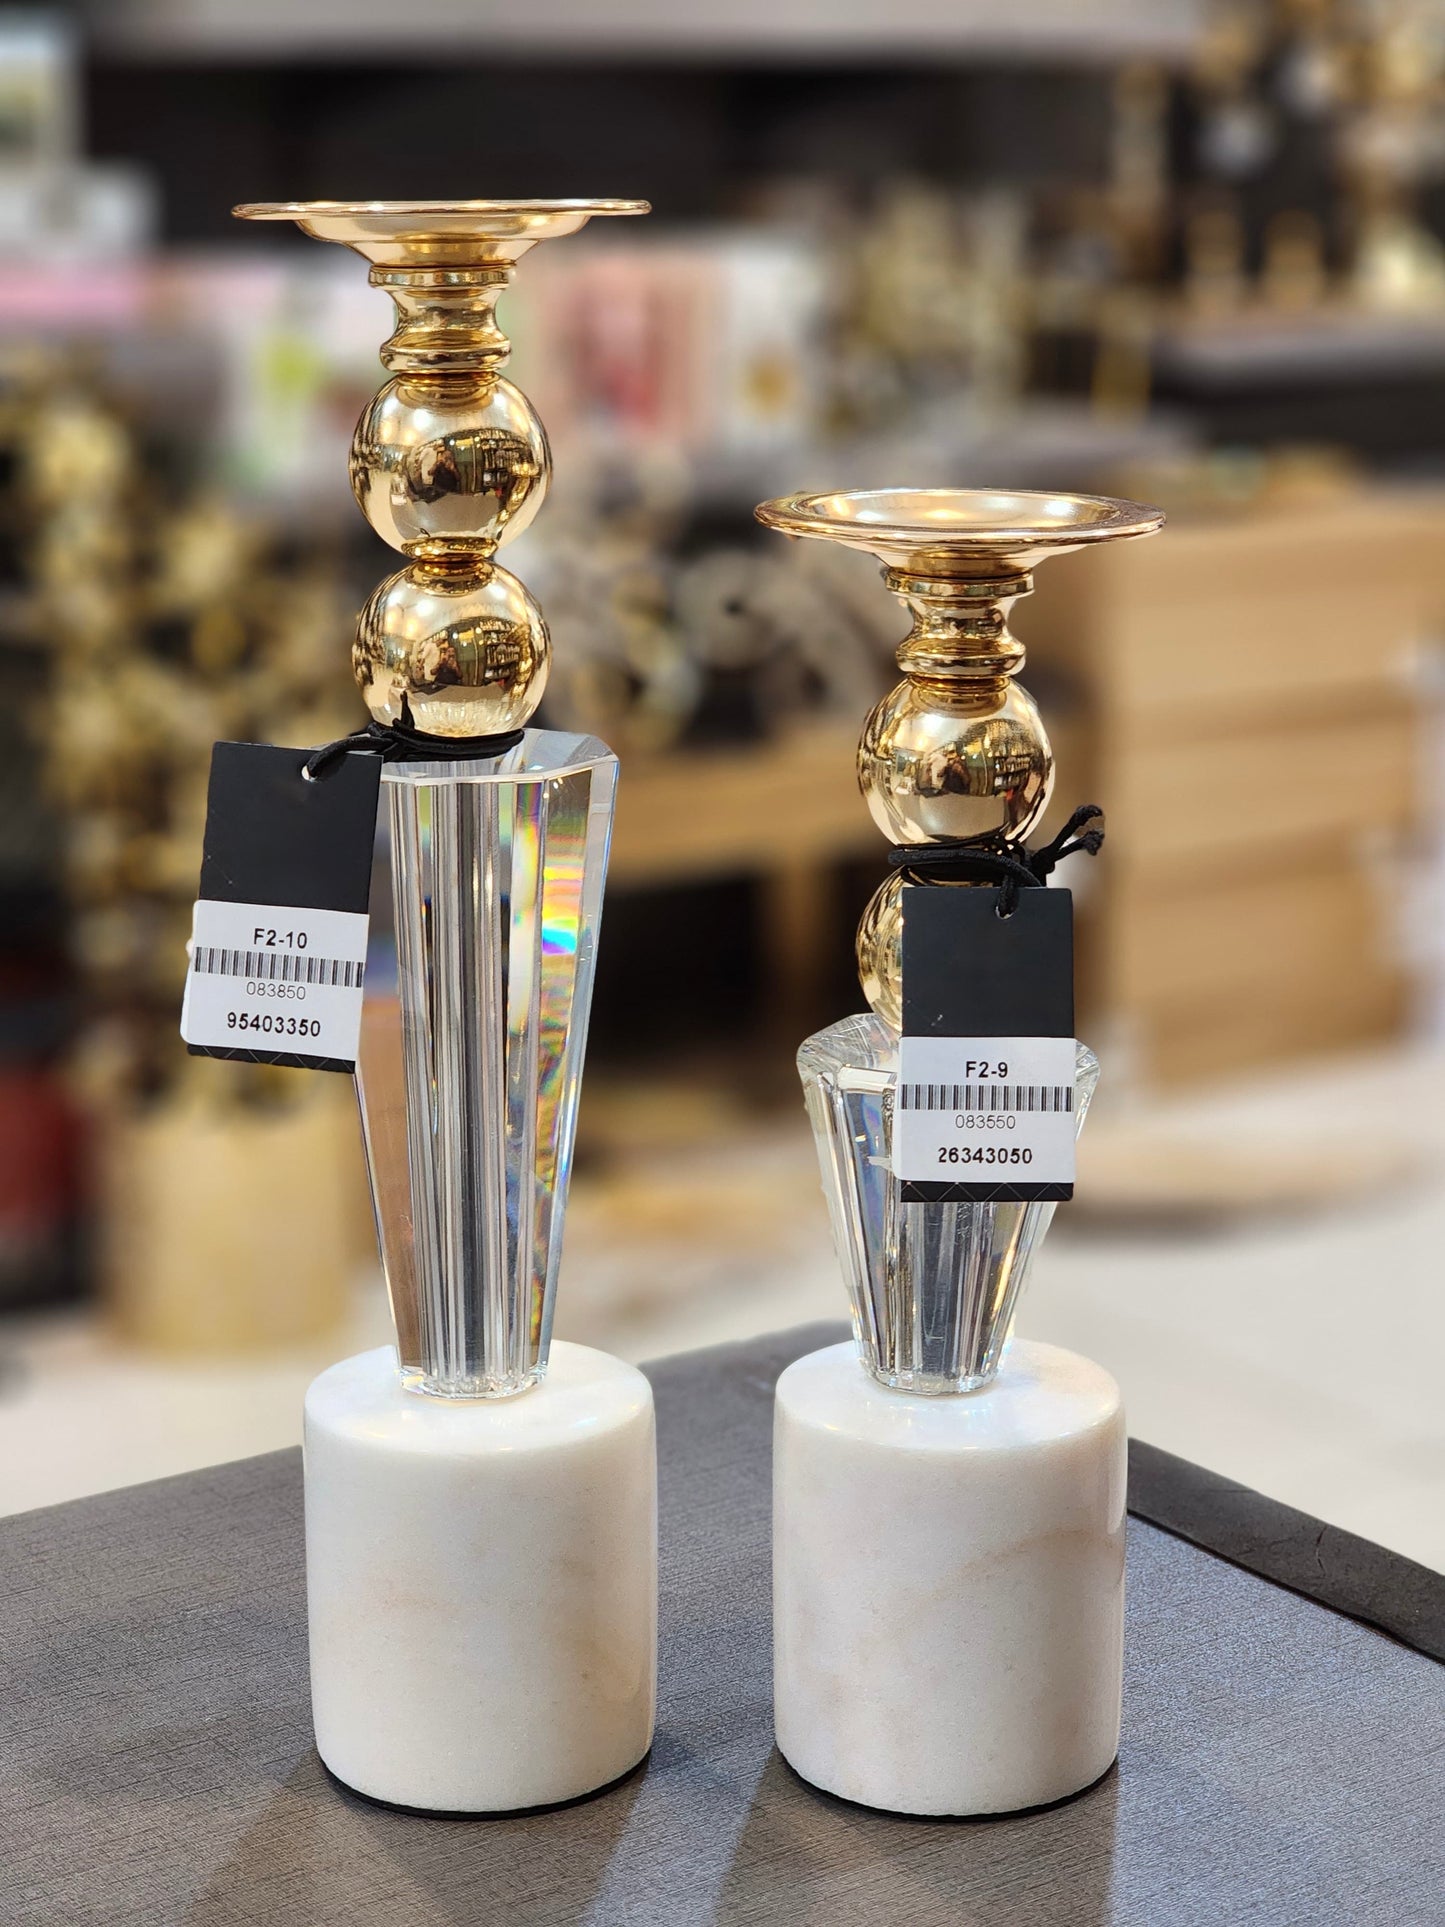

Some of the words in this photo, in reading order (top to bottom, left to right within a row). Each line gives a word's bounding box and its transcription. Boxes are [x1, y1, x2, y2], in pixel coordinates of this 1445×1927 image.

[253, 928, 308, 949] F2-10
[246, 981, 306, 1000] 083850
[227, 1012, 321, 1037] 95403350
[965, 1061, 1009, 1078] F2-9
[955, 1114, 1016, 1129] 083550
[938, 1147, 1033, 1164] 26343050
